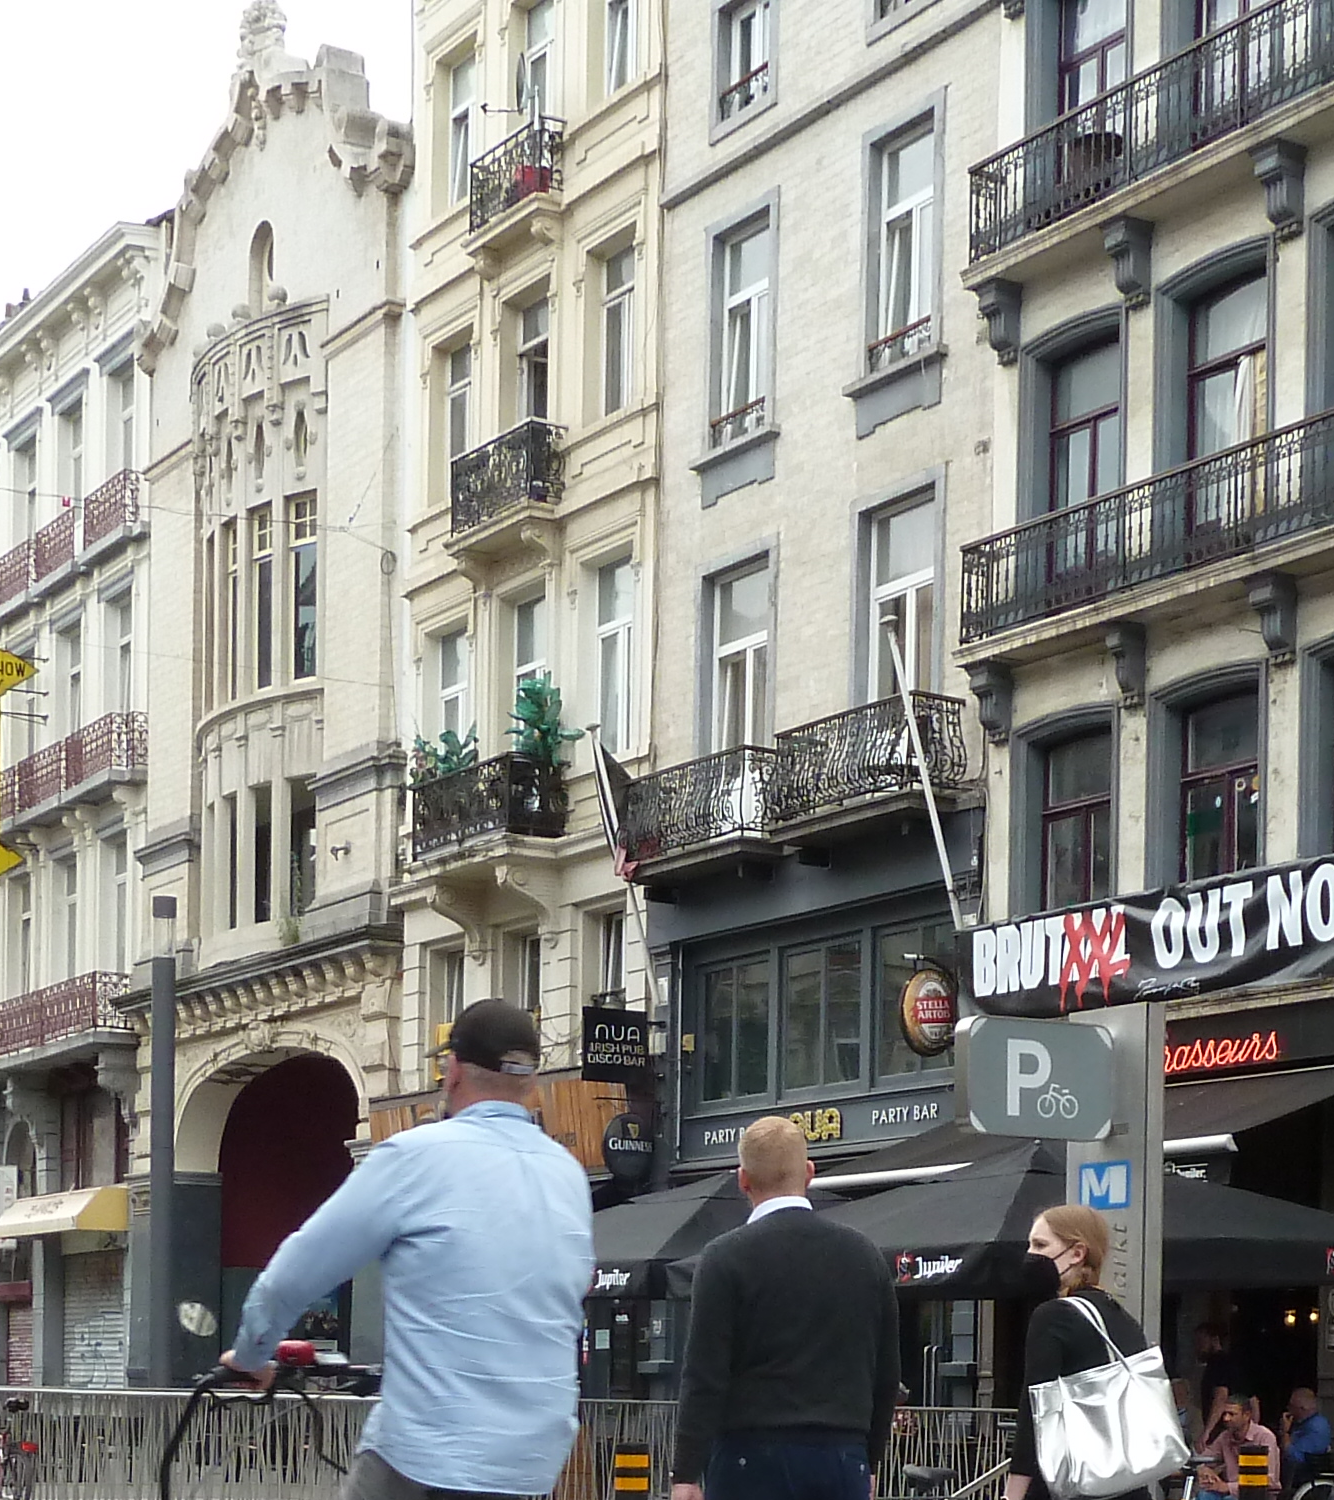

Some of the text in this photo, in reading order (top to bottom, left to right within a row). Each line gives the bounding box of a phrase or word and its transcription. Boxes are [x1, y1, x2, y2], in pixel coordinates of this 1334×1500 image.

[1150, 880, 1253, 969] OUT
[916, 1001, 949, 1010] STELLA
[917, 1010, 950, 1019] ARTOIS
[590, 1042, 645, 1055] IRISH PUB
[1165, 1031, 1279, 1072] rasseurs
[1007, 1038, 1052, 1116] P
[871, 1103, 938, 1125] PARTY BAR
[608, 1137, 653, 1153] GUINNESS
[704, 1127, 736, 1146] PARTY
[913, 1255, 964, 1279] Jupiler
[1113, 1223, 1128, 1299] arkt
[595, 1269, 631, 1290] Jupiler
